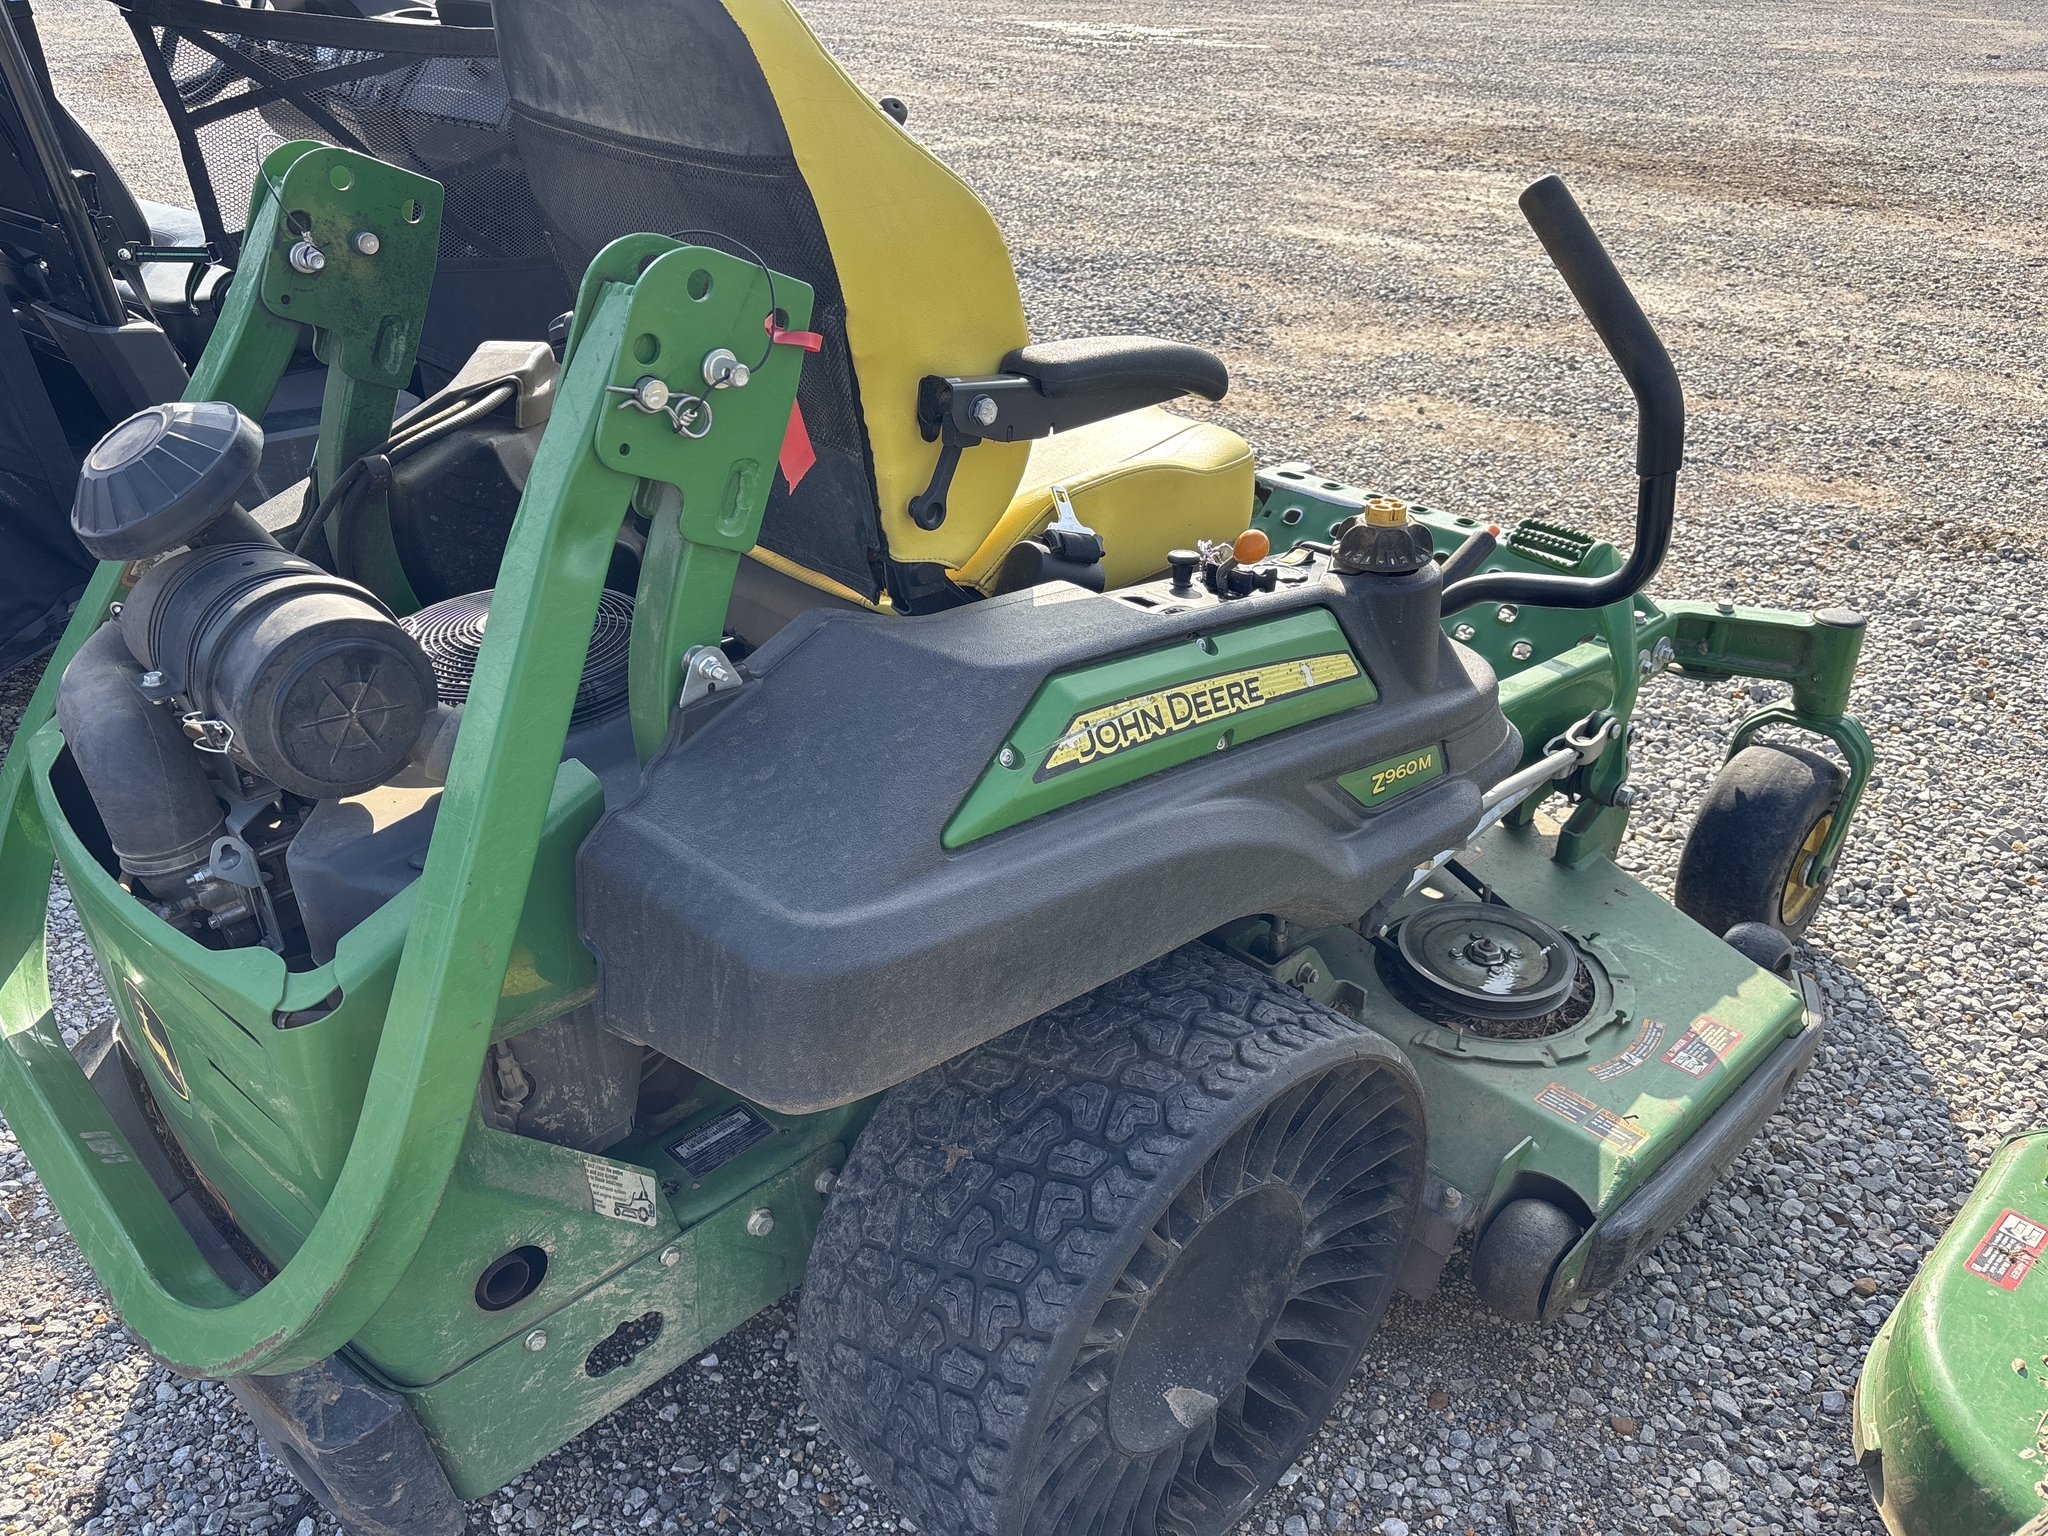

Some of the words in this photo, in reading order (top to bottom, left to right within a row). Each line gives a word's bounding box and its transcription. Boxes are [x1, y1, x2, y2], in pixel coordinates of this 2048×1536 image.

[1081, 704, 1166, 757] JOHN
[1168, 677, 1264, 725] DEERE
[1371, 754, 1433, 796] Z960M
